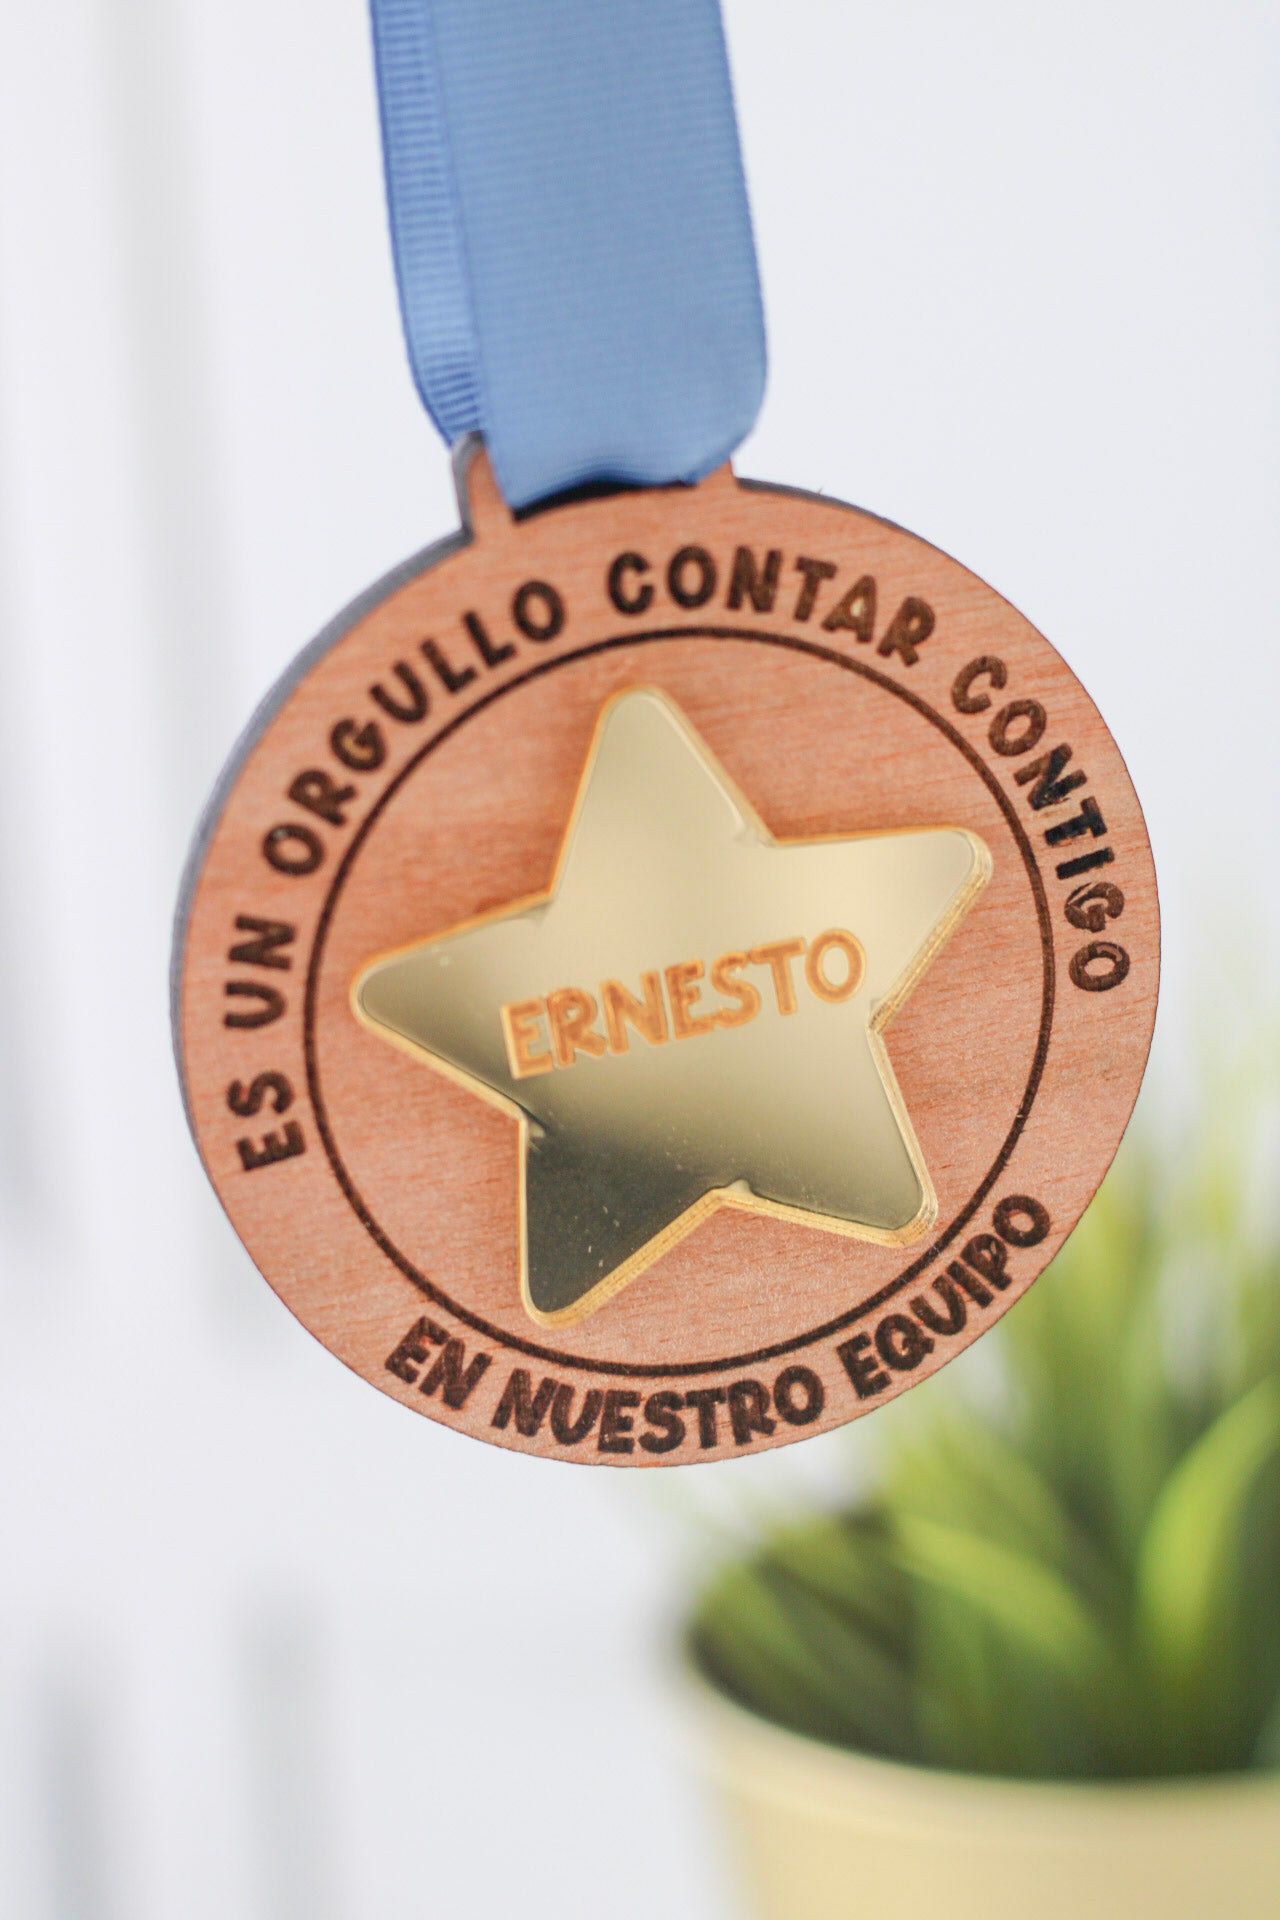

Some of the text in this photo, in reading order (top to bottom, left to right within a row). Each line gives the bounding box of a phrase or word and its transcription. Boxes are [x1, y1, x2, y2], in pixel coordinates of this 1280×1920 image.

[222, 544, 1132, 1174] ES UN ORGULLO CONTAR CONTIGO
[500, 928, 867, 1080] ERNESTO
[384, 1193, 1053, 1455] EN NUESTRO EQUIPO
